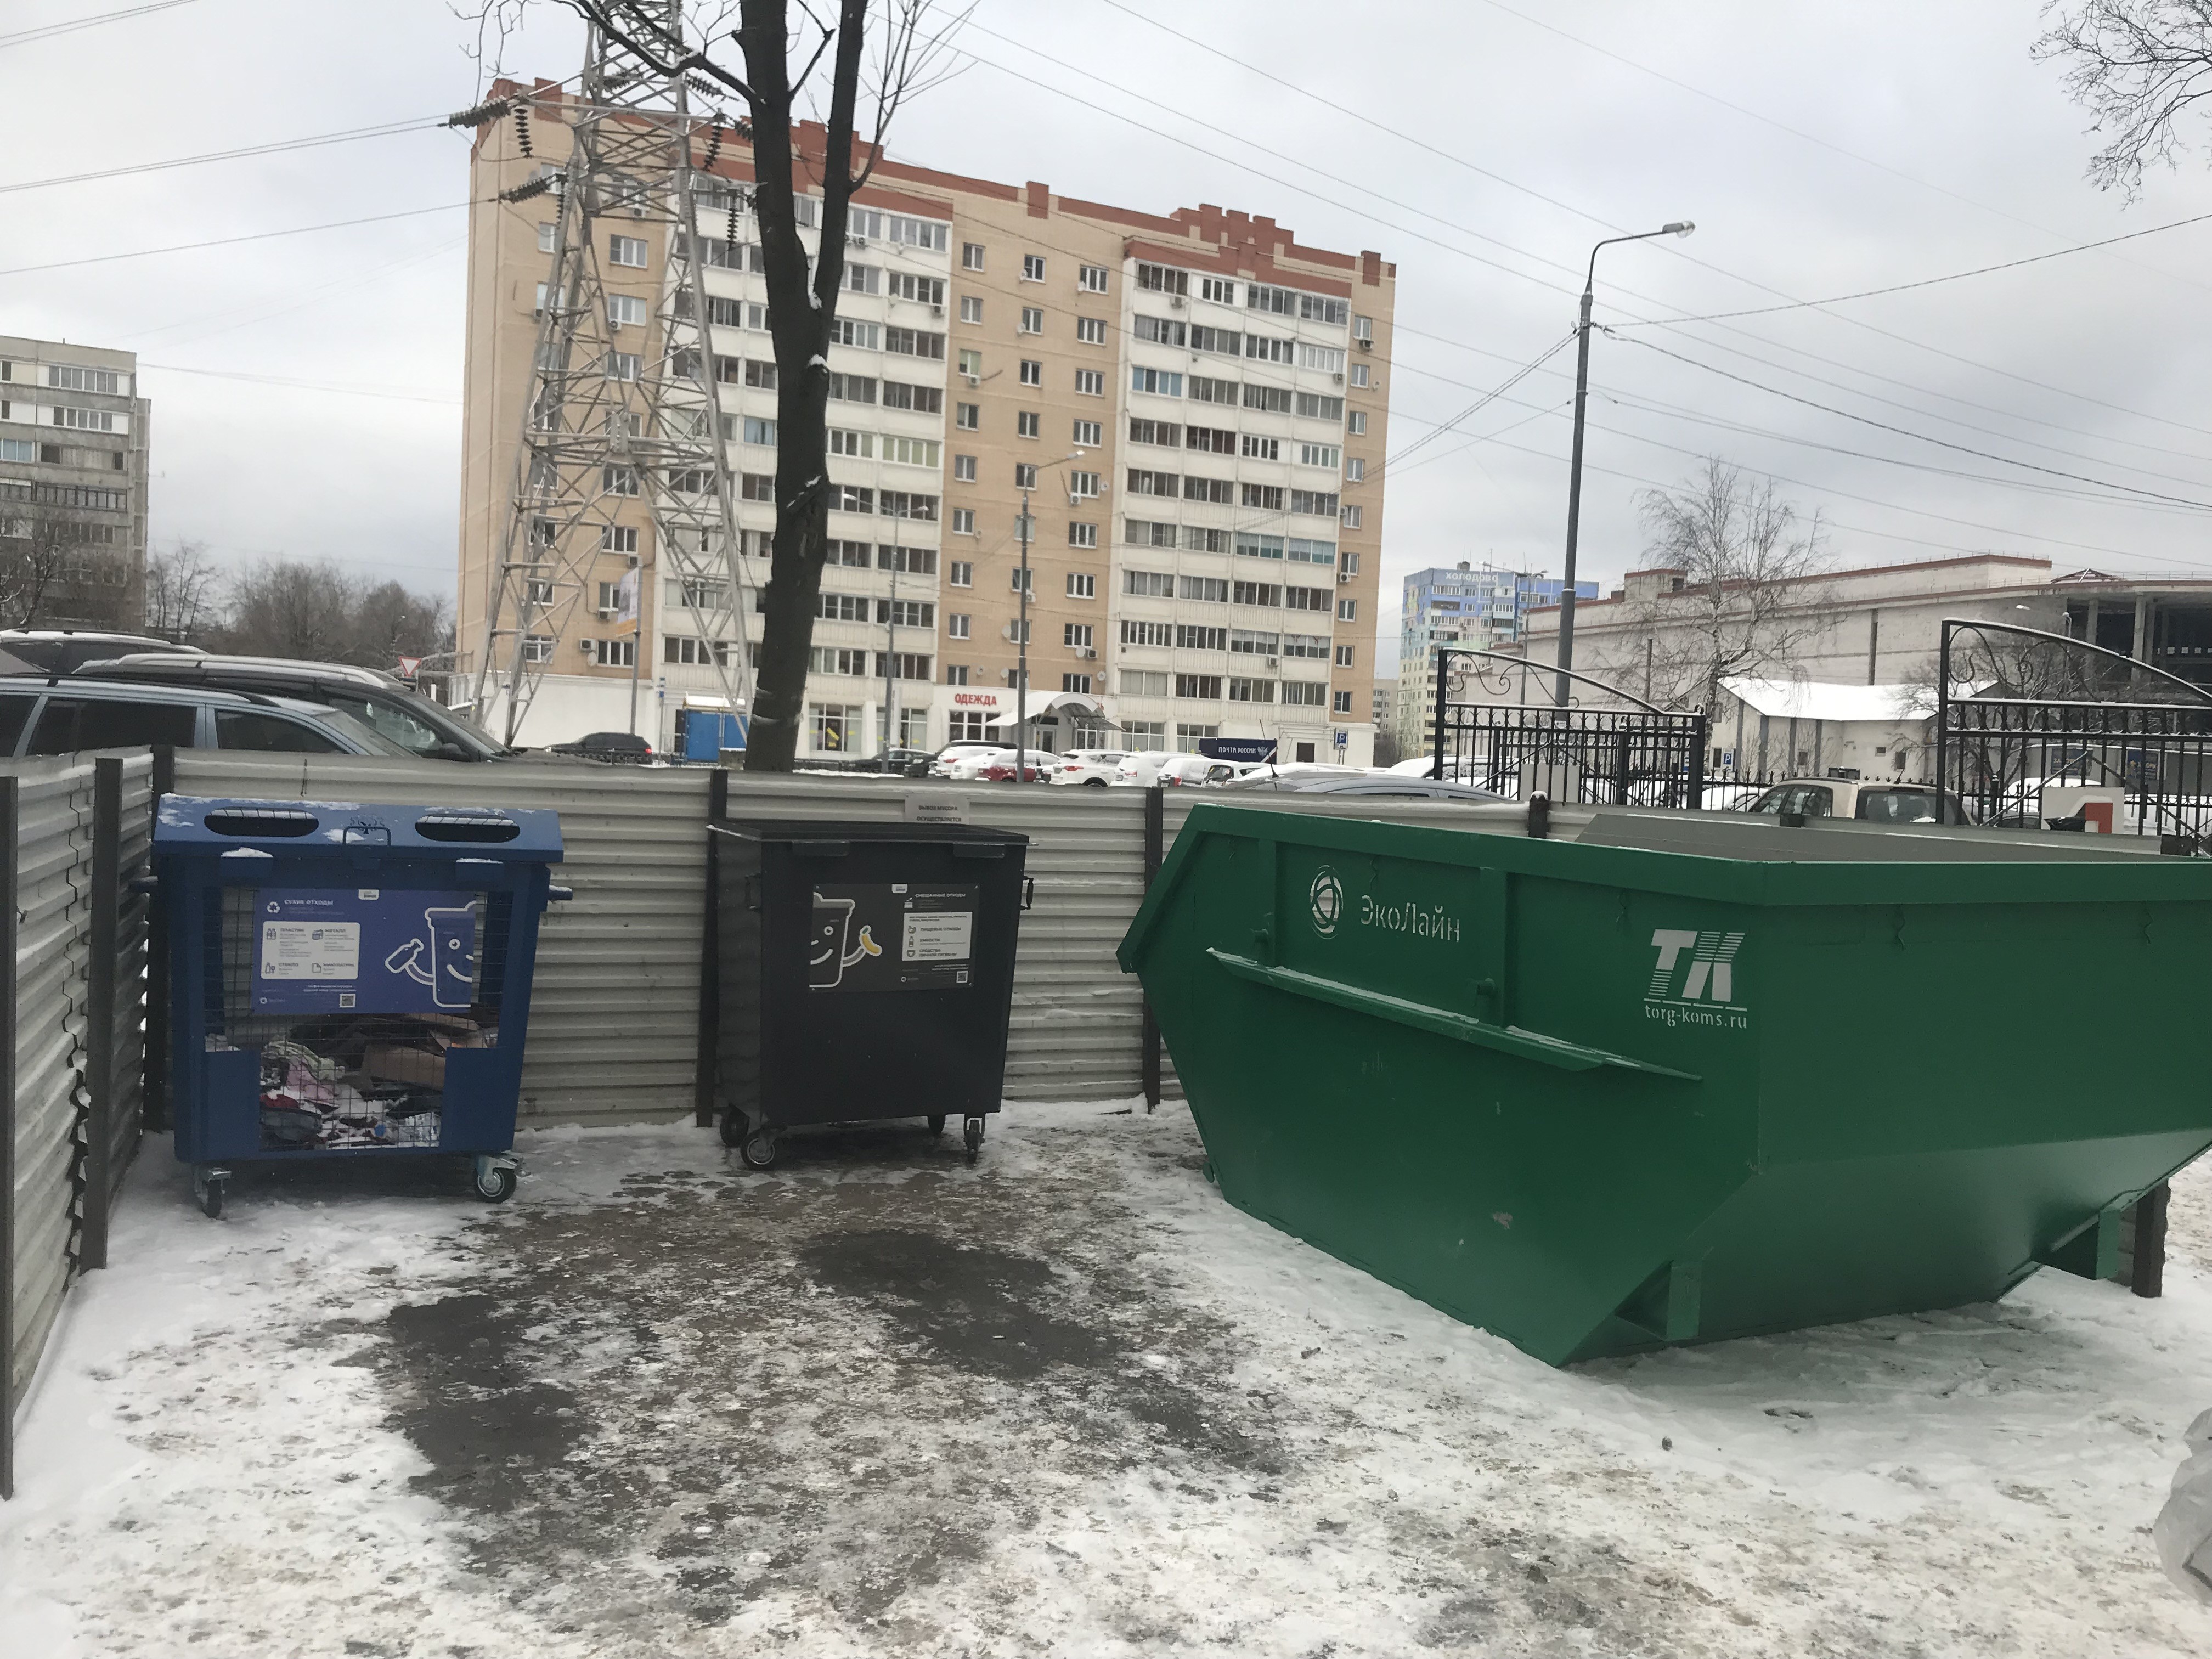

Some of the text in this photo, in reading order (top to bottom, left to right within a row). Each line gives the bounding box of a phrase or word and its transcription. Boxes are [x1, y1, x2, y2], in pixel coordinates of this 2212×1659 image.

[955, 693, 997, 706] ОДЕЖДА
[1361, 895, 1460, 943] ЭкоЛайн
[1645, 1005, 1747, 1029] torg-koms.ru
